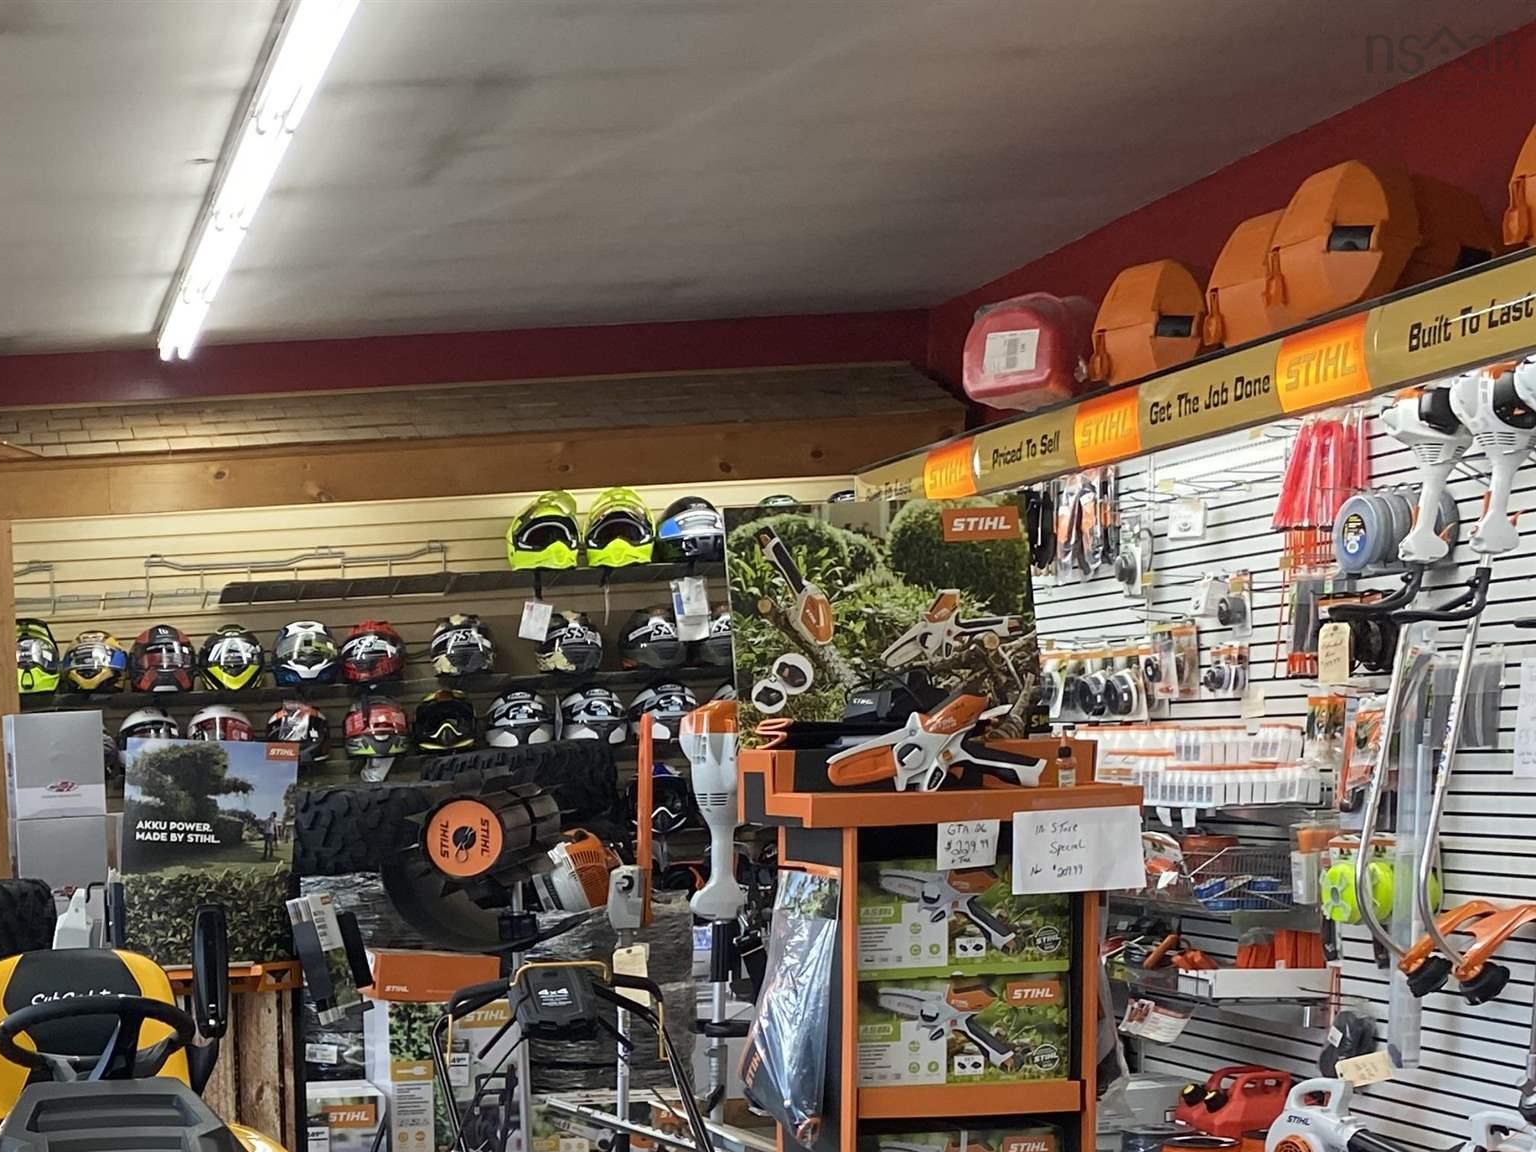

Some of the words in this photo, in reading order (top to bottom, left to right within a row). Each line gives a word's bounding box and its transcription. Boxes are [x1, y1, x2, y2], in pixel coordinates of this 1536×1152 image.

[1408, 313, 1452, 353] Built
[1460, 305, 1480, 337] To
[1488, 292, 1535, 331] Last
[1285, 340, 1358, 393] STIHL
[1149, 398, 1172, 426] Get
[1177, 392, 1200, 418] The
[1204, 384, 1229, 411] Job
[1233, 374, 1271, 403] Done
[1080, 412, 1132, 449] STIHL
[991, 444, 1023, 470] Priced
[1025, 438, 1037, 458] To
[1039, 430, 1061, 456] Sell
[928, 459, 967, 490] STIHL
[951, 517, 1012, 532] STIHL
[269, 748, 296, 756] STIHL
[135, 821, 168, 831] AKKU
[169, 822, 213, 832] POWER.
[135, 832, 169, 842] MADE
[170, 833, 185, 843] BY
[186, 834, 221, 844] STIHL.
[440, 820, 450, 859] STIHL
[480, 817, 491, 857] STIHL
[384, 985, 410, 993] STIHL
[538, 987, 569, 997] 4x4
[1013, 987, 1055, 999] STIHL
[465, 1008, 510, 1021] STIHL
[328, 1111, 370, 1122] STIHL
[1287, 1114, 1311, 1127] STIHL
[1009, 1141, 1049, 1152] STIHL
